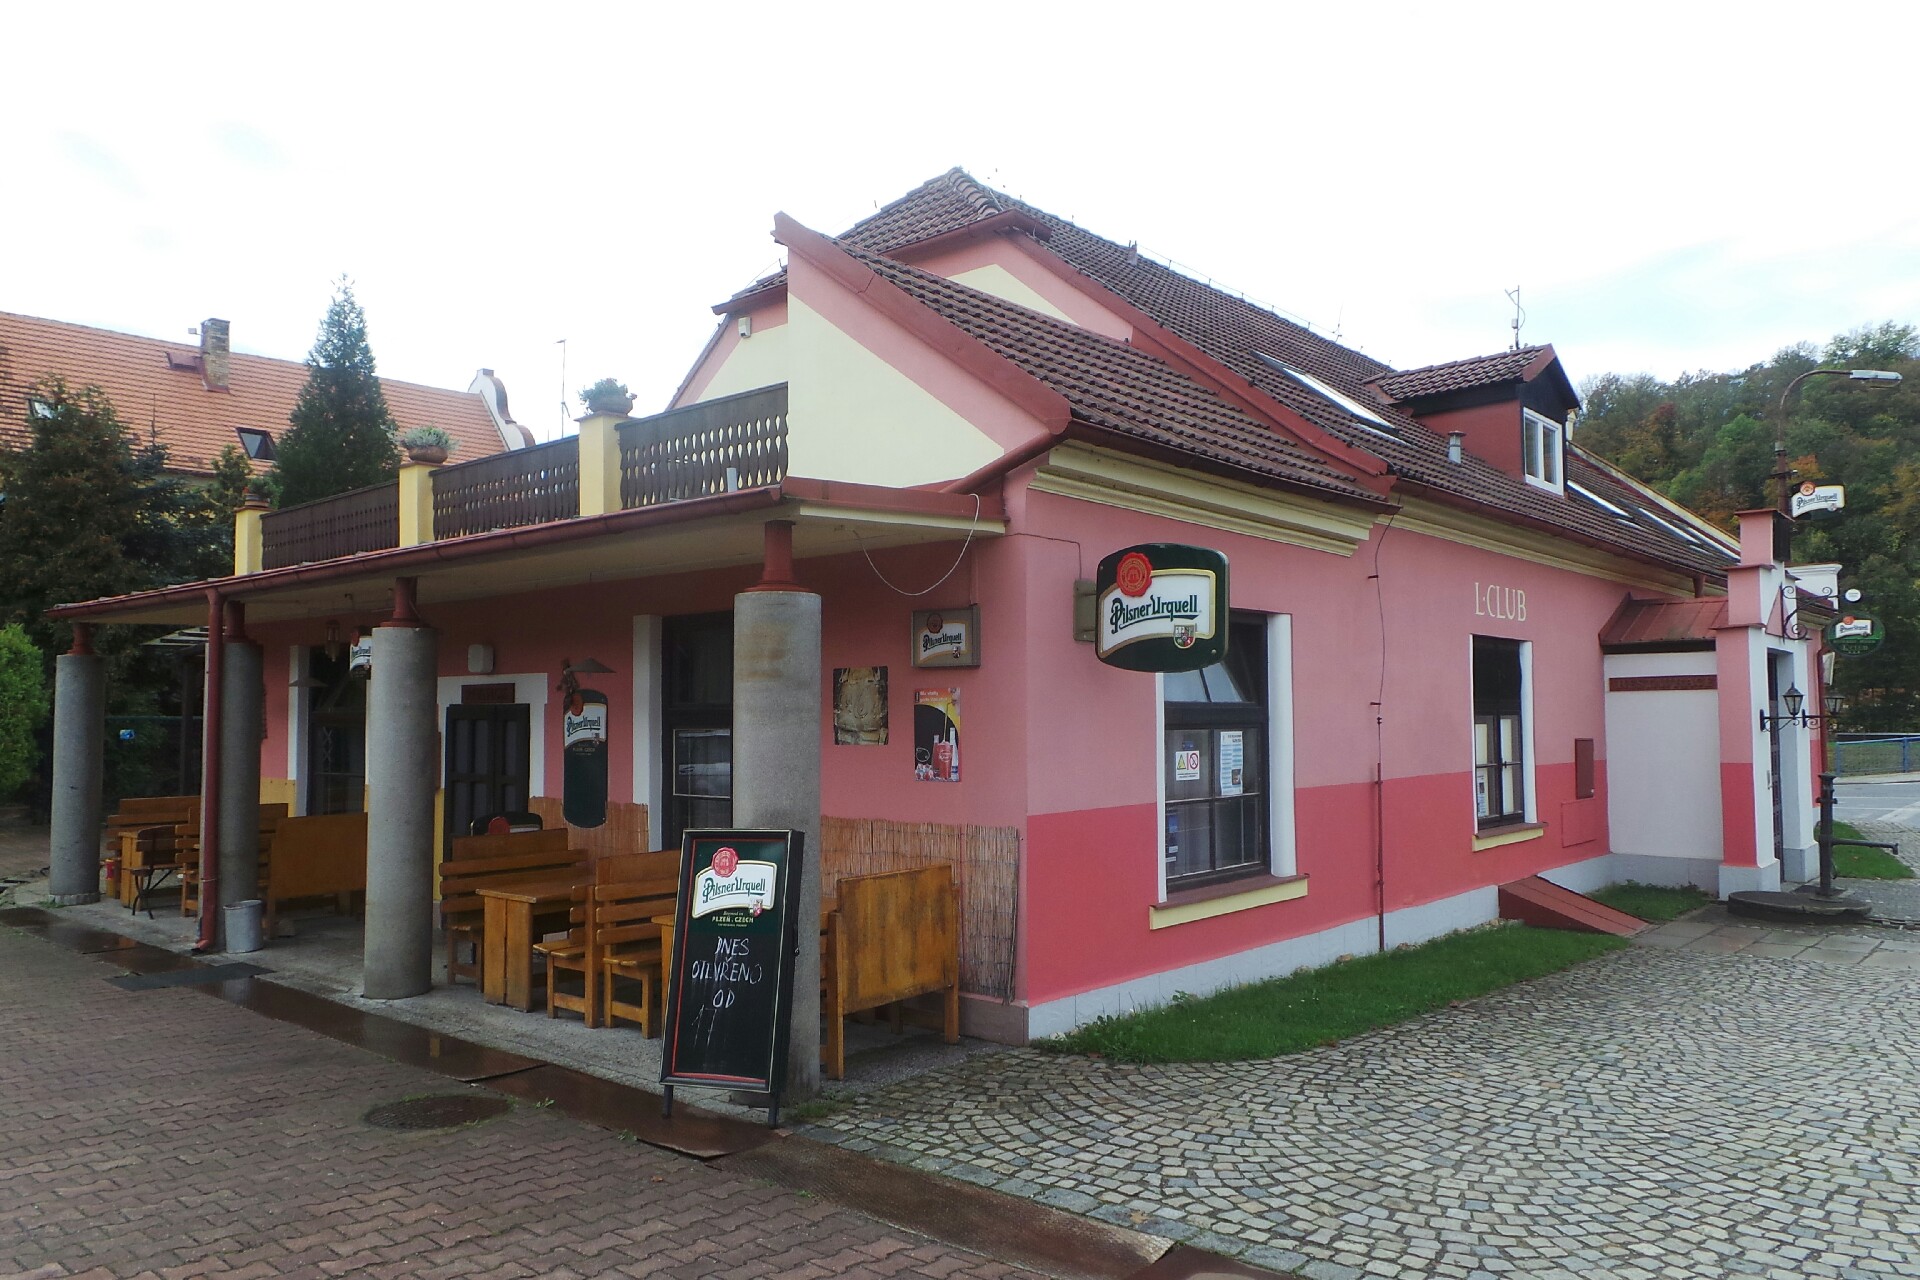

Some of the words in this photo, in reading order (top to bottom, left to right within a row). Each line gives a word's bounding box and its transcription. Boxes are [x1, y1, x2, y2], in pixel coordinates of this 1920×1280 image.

[1109, 597, 1151, 634] Pilsner
[1150, 595, 1198, 622] Urquell
[942, 633, 962, 646] Urquell
[702, 877, 735, 903] Pilsner
[734, 876, 766, 897] Urquell
[712, 988, 736, 1009] OD
